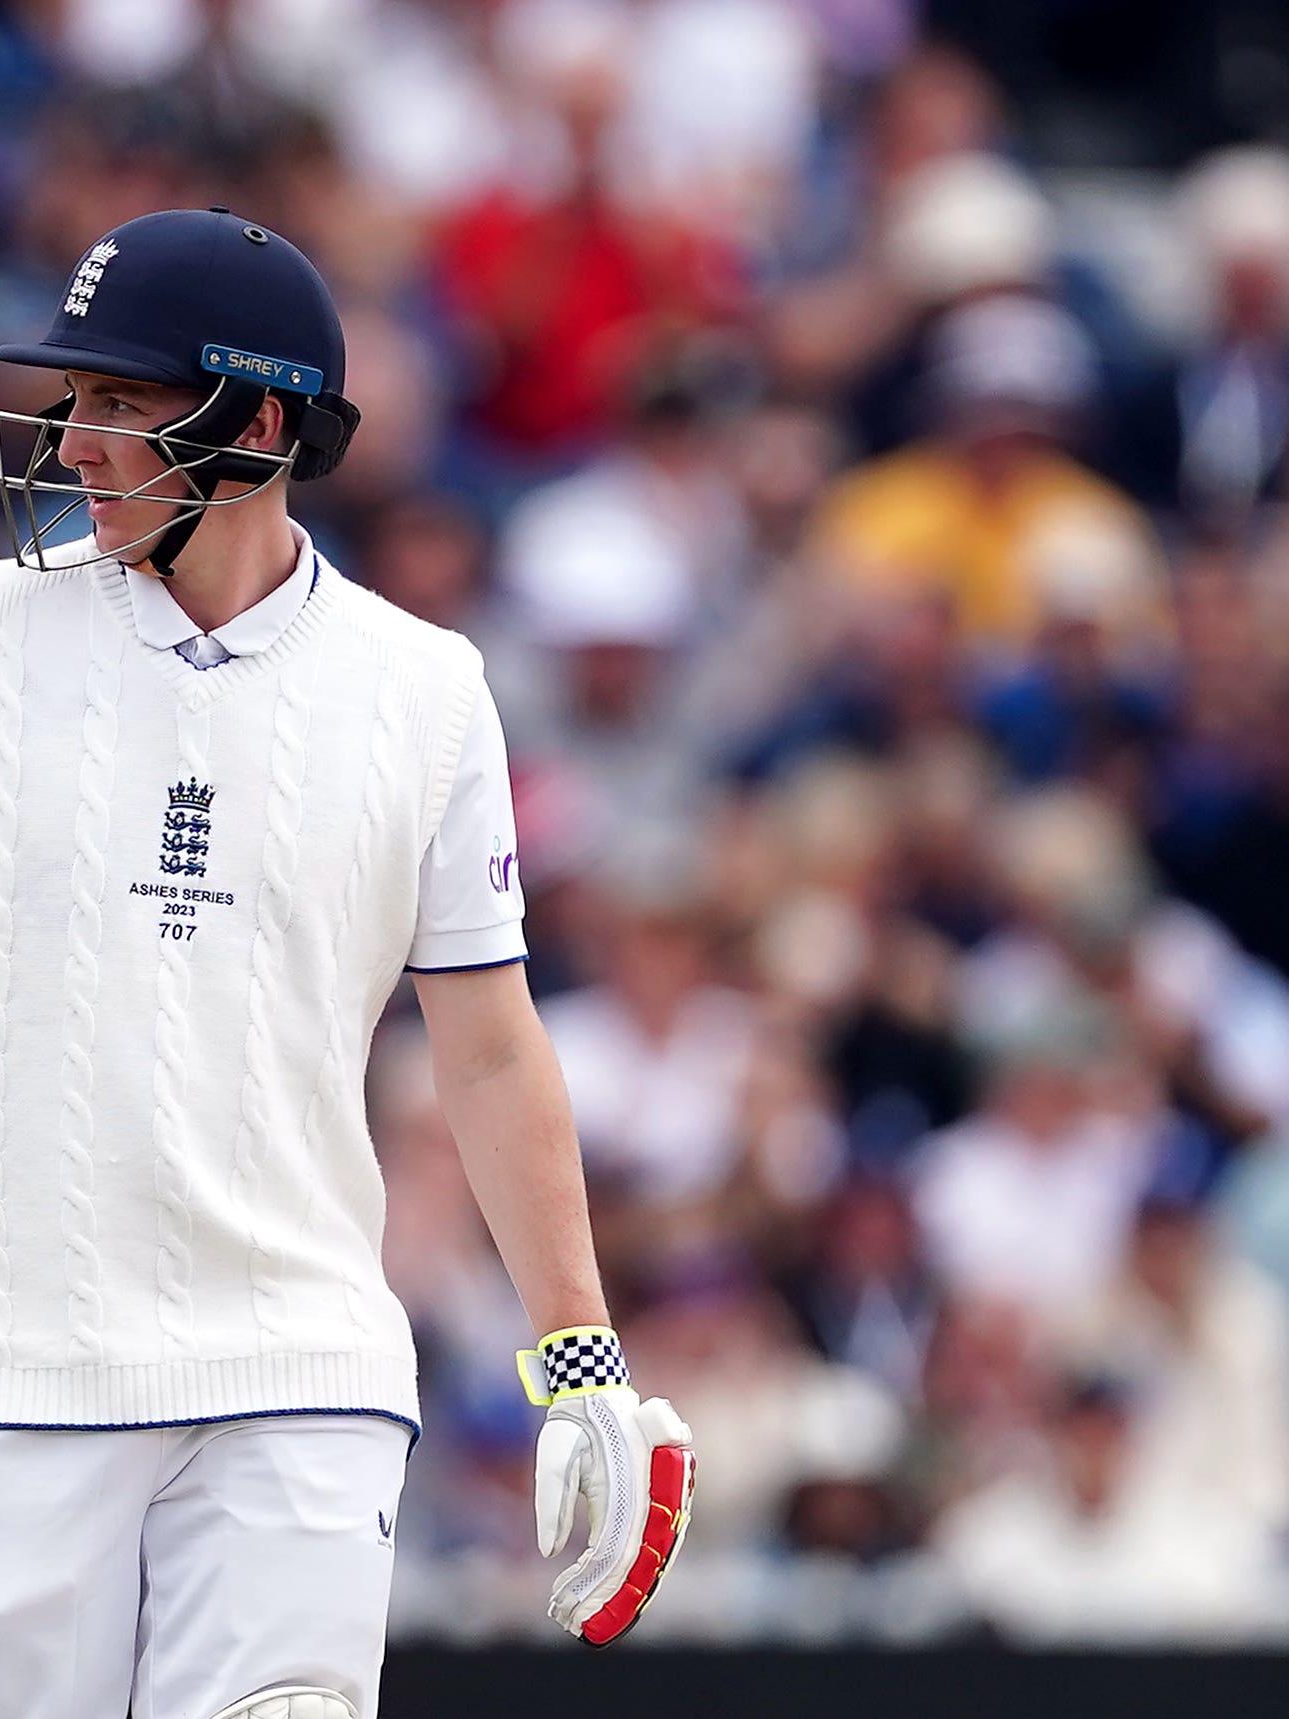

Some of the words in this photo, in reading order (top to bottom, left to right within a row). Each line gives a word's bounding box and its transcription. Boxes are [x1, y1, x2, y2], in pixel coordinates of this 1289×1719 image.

[227, 353, 284, 377] SHREY
[129, 883, 177, 898] ASHES
[182, 889, 235, 905] SERIES
[162, 903, 196, 916] 2023
[159, 923, 197, 941] 707
